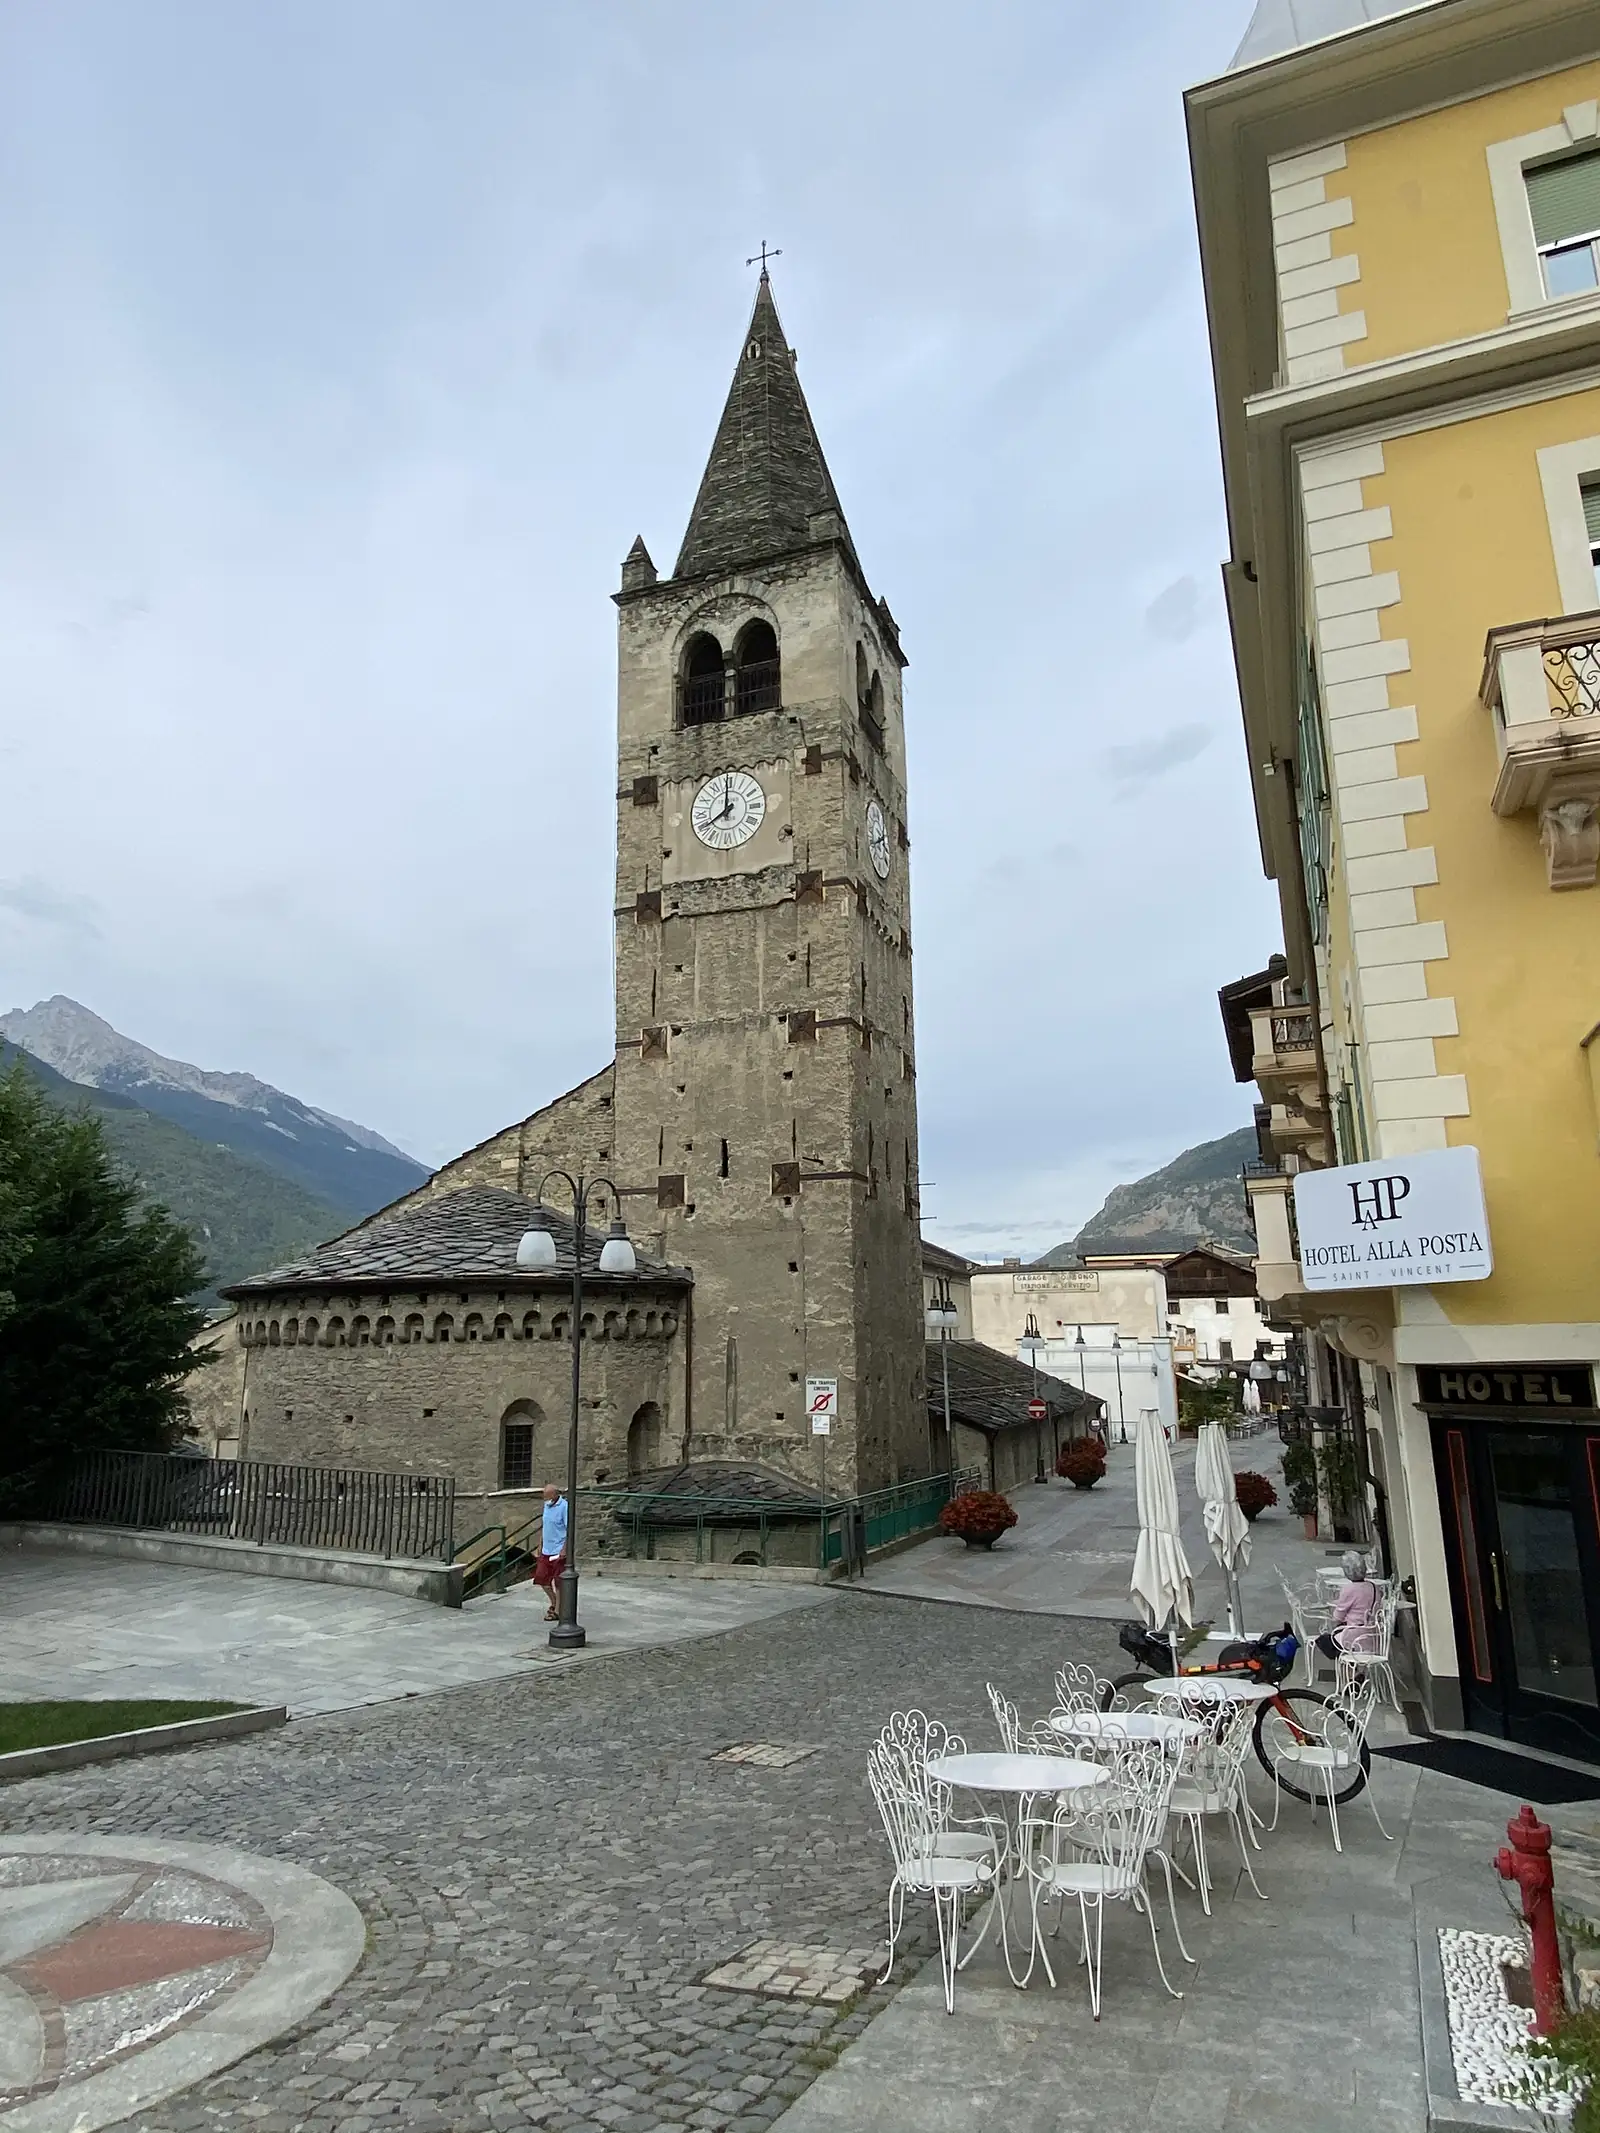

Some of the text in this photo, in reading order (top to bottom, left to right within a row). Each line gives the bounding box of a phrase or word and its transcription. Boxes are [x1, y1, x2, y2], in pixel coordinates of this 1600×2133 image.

[1305, 1231, 1483, 1266] HOTEL ALLA POSTA
[1332, 1270, 1370, 1282] SAINT
[1391, 1263, 1452, 1277] VINCENT
[1439, 1372, 1573, 1403] HOTEL
